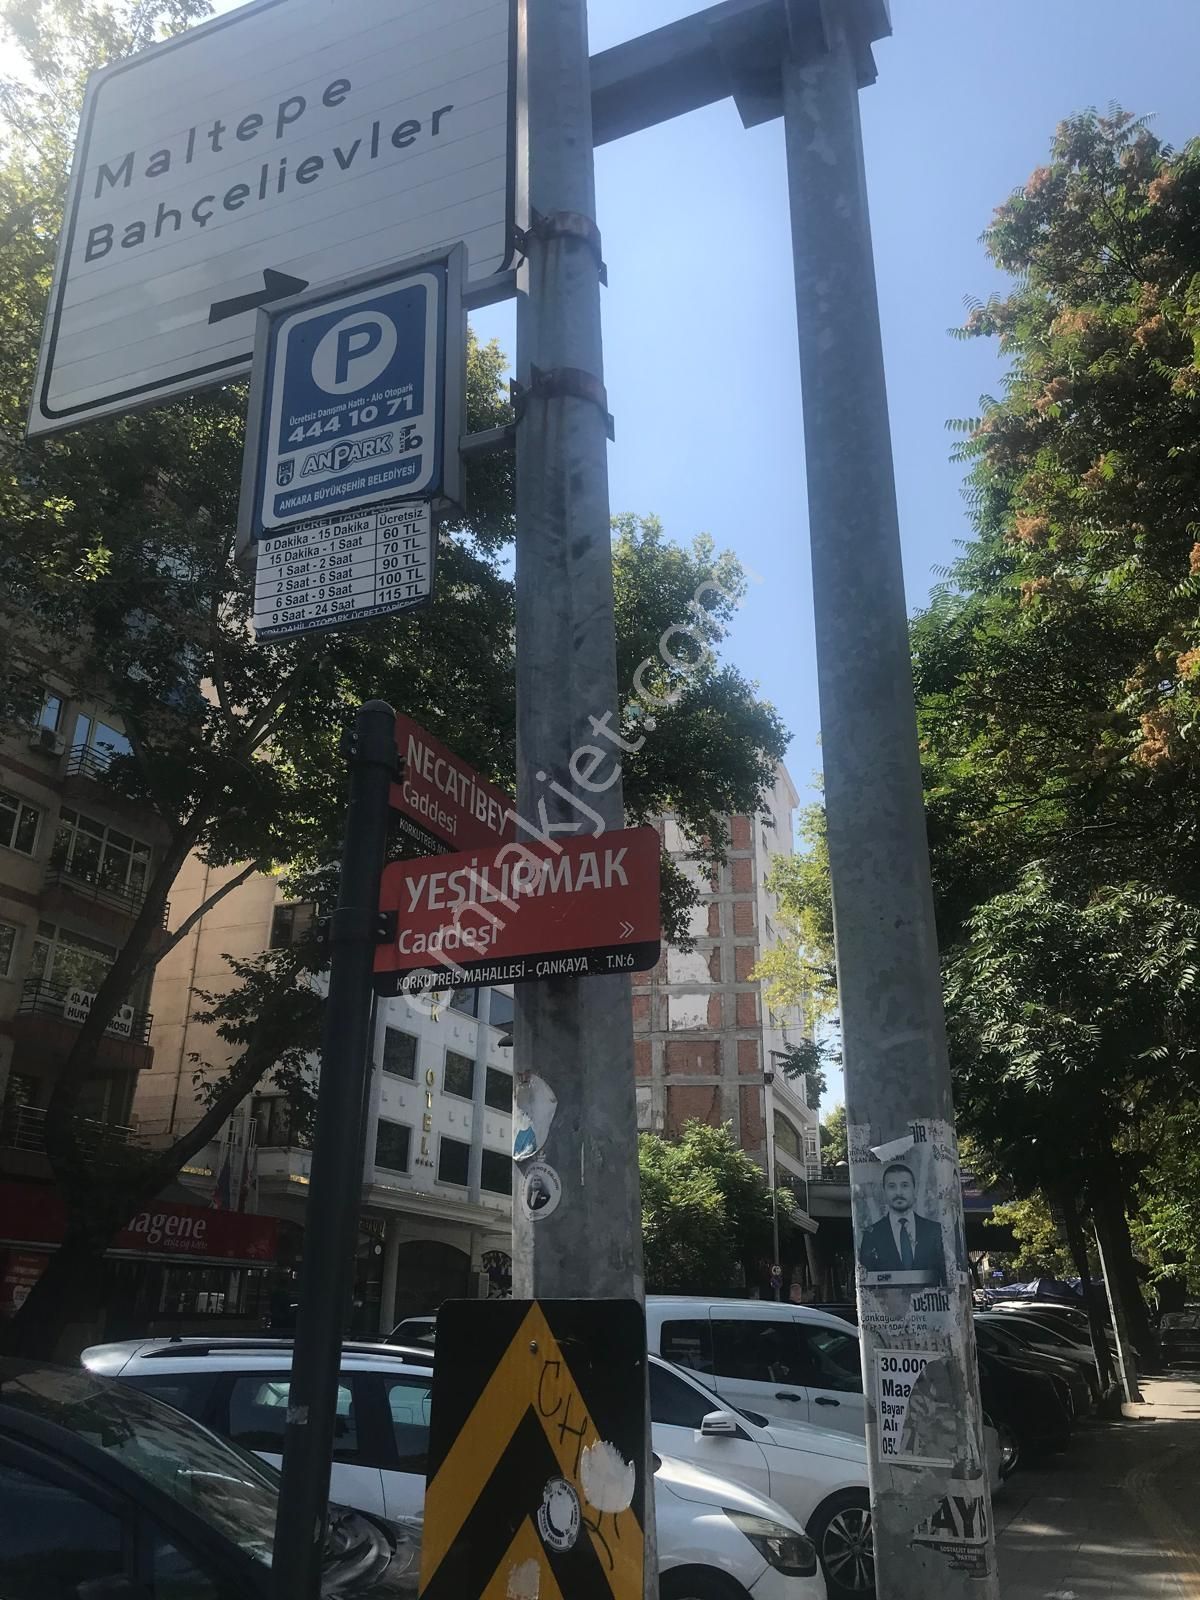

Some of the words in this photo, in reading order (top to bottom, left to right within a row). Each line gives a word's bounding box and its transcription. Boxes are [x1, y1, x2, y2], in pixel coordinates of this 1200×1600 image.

[94, 79, 351, 199] Maltepe
[84, 104, 453, 263] Bahçelievler
[335, 322, 383, 385] P
[288, 416, 341, 442] 444
[349, 405, 378, 426] 10
[387, 394, 413, 416] 71
[290, 410, 316, 426] Ücretsiz
[318, 403, 347, 418] Danışma
[348, 399, 365, 409] Hattı
[371, 391, 383, 403] Alo
[385, 383, 414, 400] Otopark
[301, 433, 392, 477] ANPARK
[279, 493, 312, 511] ANKARA
[314, 477, 366, 500] BÜYÜKŞEHİR
[368, 463, 416, 486] BELEDİYESİ
[379, 508, 423, 526] Ücretsiz
[383, 528, 399, 539] 60
[403, 523, 421, 536] TL
[265, 542, 271, 553] 0
[273, 534, 309, 551] Dakika
[318, 529, 331, 540] 15
[333, 520, 369, 537] Dakika
[270, 554, 281, 565] 15
[284, 544, 320, 563] Dakika
[330, 541, 335, 551] 1
[338, 535, 363, 550] Saat
[383, 543, 398, 554] 70
[403, 537, 420, 550] TL
[278, 568, 283, 577] 1
[286, 562, 310, 577] Saat
[320, 558, 326, 569] 2
[329, 553, 353, 567] Saat
[378, 572, 401, 586] 100
[406, 568, 423, 580] TL
[382, 557, 398, 570] 90
[403, 553, 420, 565] TL
[276, 597, 282, 608] 6
[285, 592, 310, 606] Saat
[319, 588, 325, 599] 9
[328, 583, 353, 597] Saat
[277, 582, 283, 592] 2
[286, 577, 310, 591] Saat
[319, 573, 326, 583] 6
[328, 568, 353, 582] Saat
[378, 589, 401, 602] 115
[405, 584, 423, 597] TL
[272, 613, 278, 624] 9
[282, 607, 307, 622] Saat
[315, 604, 328, 616] 24
[330, 599, 355, 612] Saat
[407, 734, 508, 836] NECATİBEY
[402, 779, 457, 837] Caddesi
[405, 848, 629, 913] YEŞİLIRMAK
[399, 917, 500, 955] Caddesi
[397, 969, 460, 991] KORKUTREİS
[464, 961, 525, 983] MAHALLESİ
[536, 956, 588, 977] ÇANKAYA
[606, 955, 634, 969] T.N:6
[68, 1007, 88, 1020] HUK
[108, 1021, 130, 1033] ROSU
[420, 1067, 434, 1156] OTEL
[128, 1212, 206, 1244] agene
